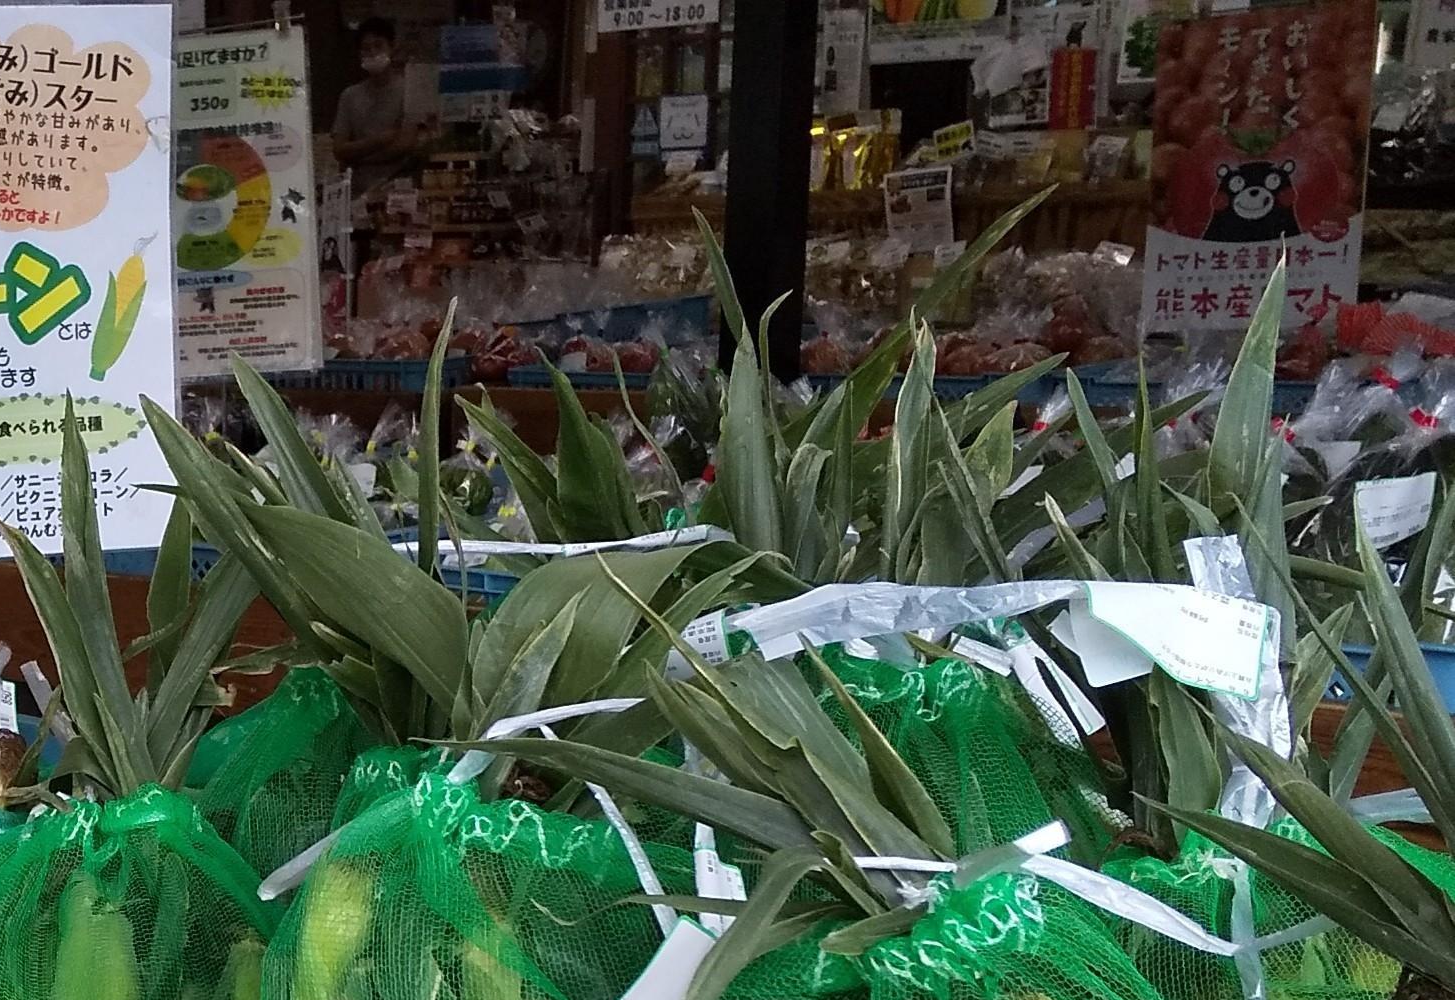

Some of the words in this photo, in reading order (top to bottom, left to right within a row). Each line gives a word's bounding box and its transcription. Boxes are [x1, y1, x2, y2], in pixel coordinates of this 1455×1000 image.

[190, 96, 230, 112] 350g
[1154, 283, 1342, 320] 熊本産マト
[58, 321, 92, 342] とは
